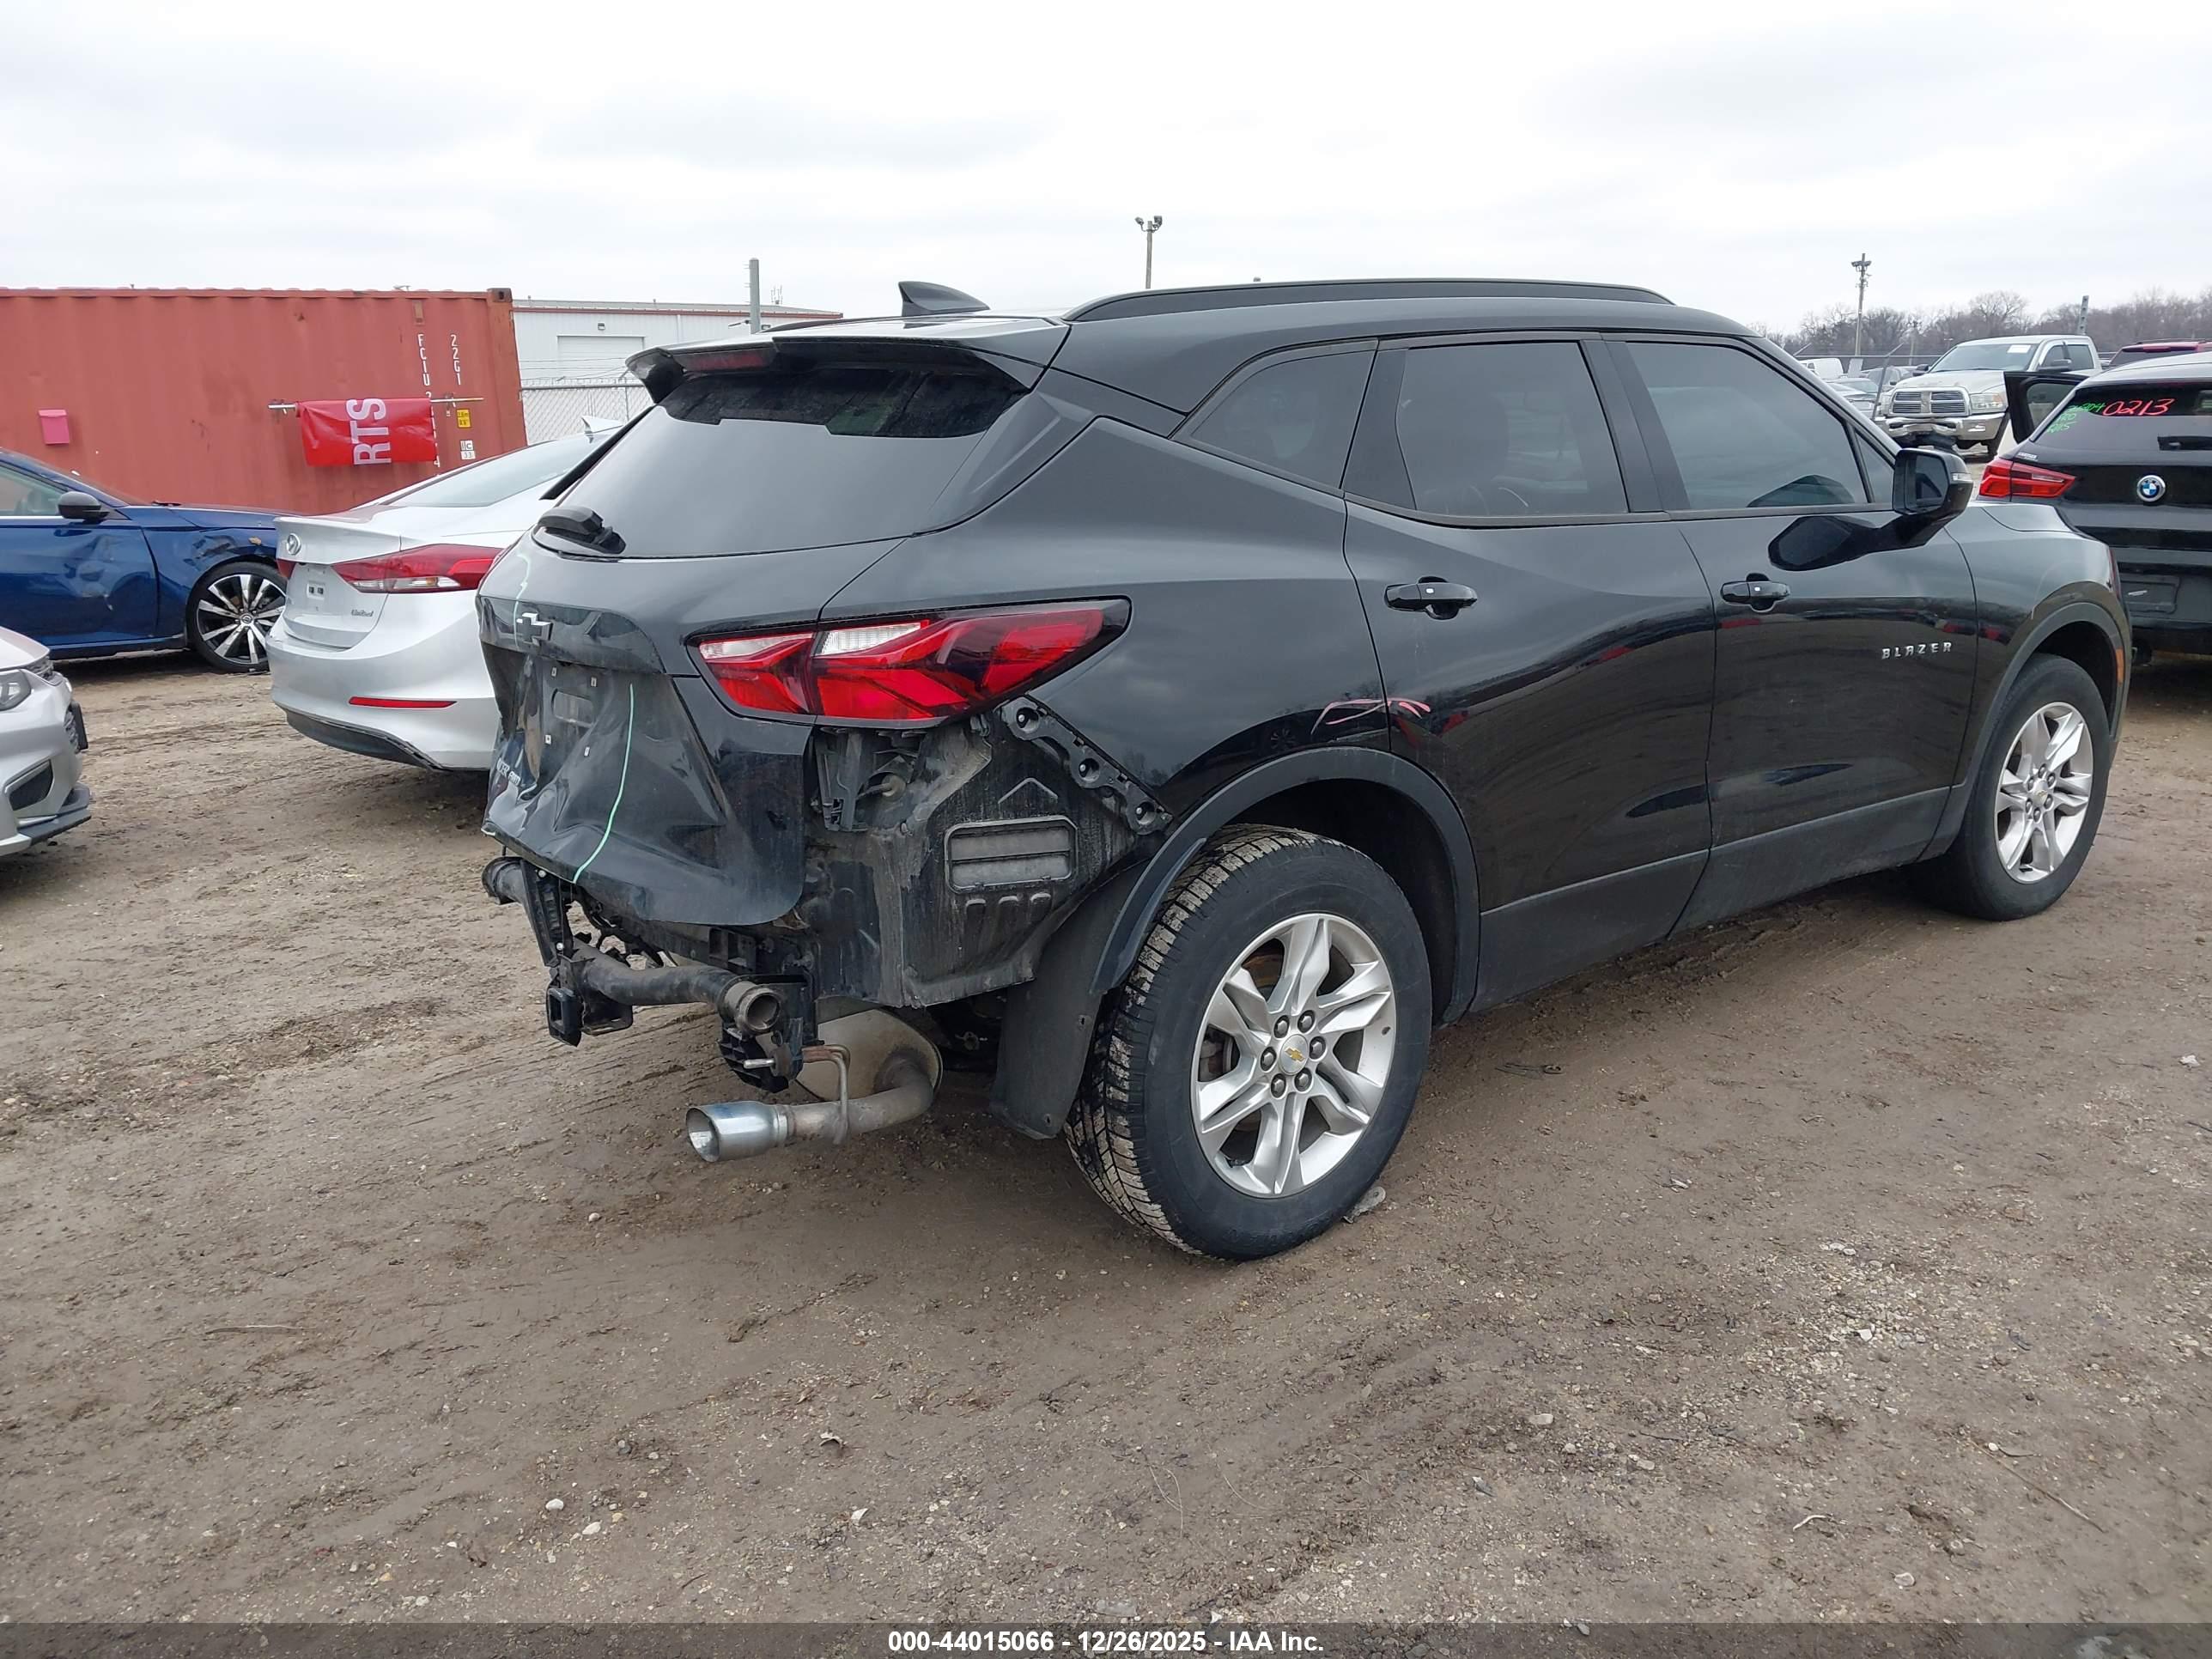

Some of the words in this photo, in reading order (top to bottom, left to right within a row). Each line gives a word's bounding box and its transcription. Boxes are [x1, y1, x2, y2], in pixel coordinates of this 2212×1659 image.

[417, 333, 430, 386] FCIU
[2102, 398, 2176, 416] 0213
[346, 398, 392, 465] RTS
[1881, 641, 1952, 659] BLAZER
